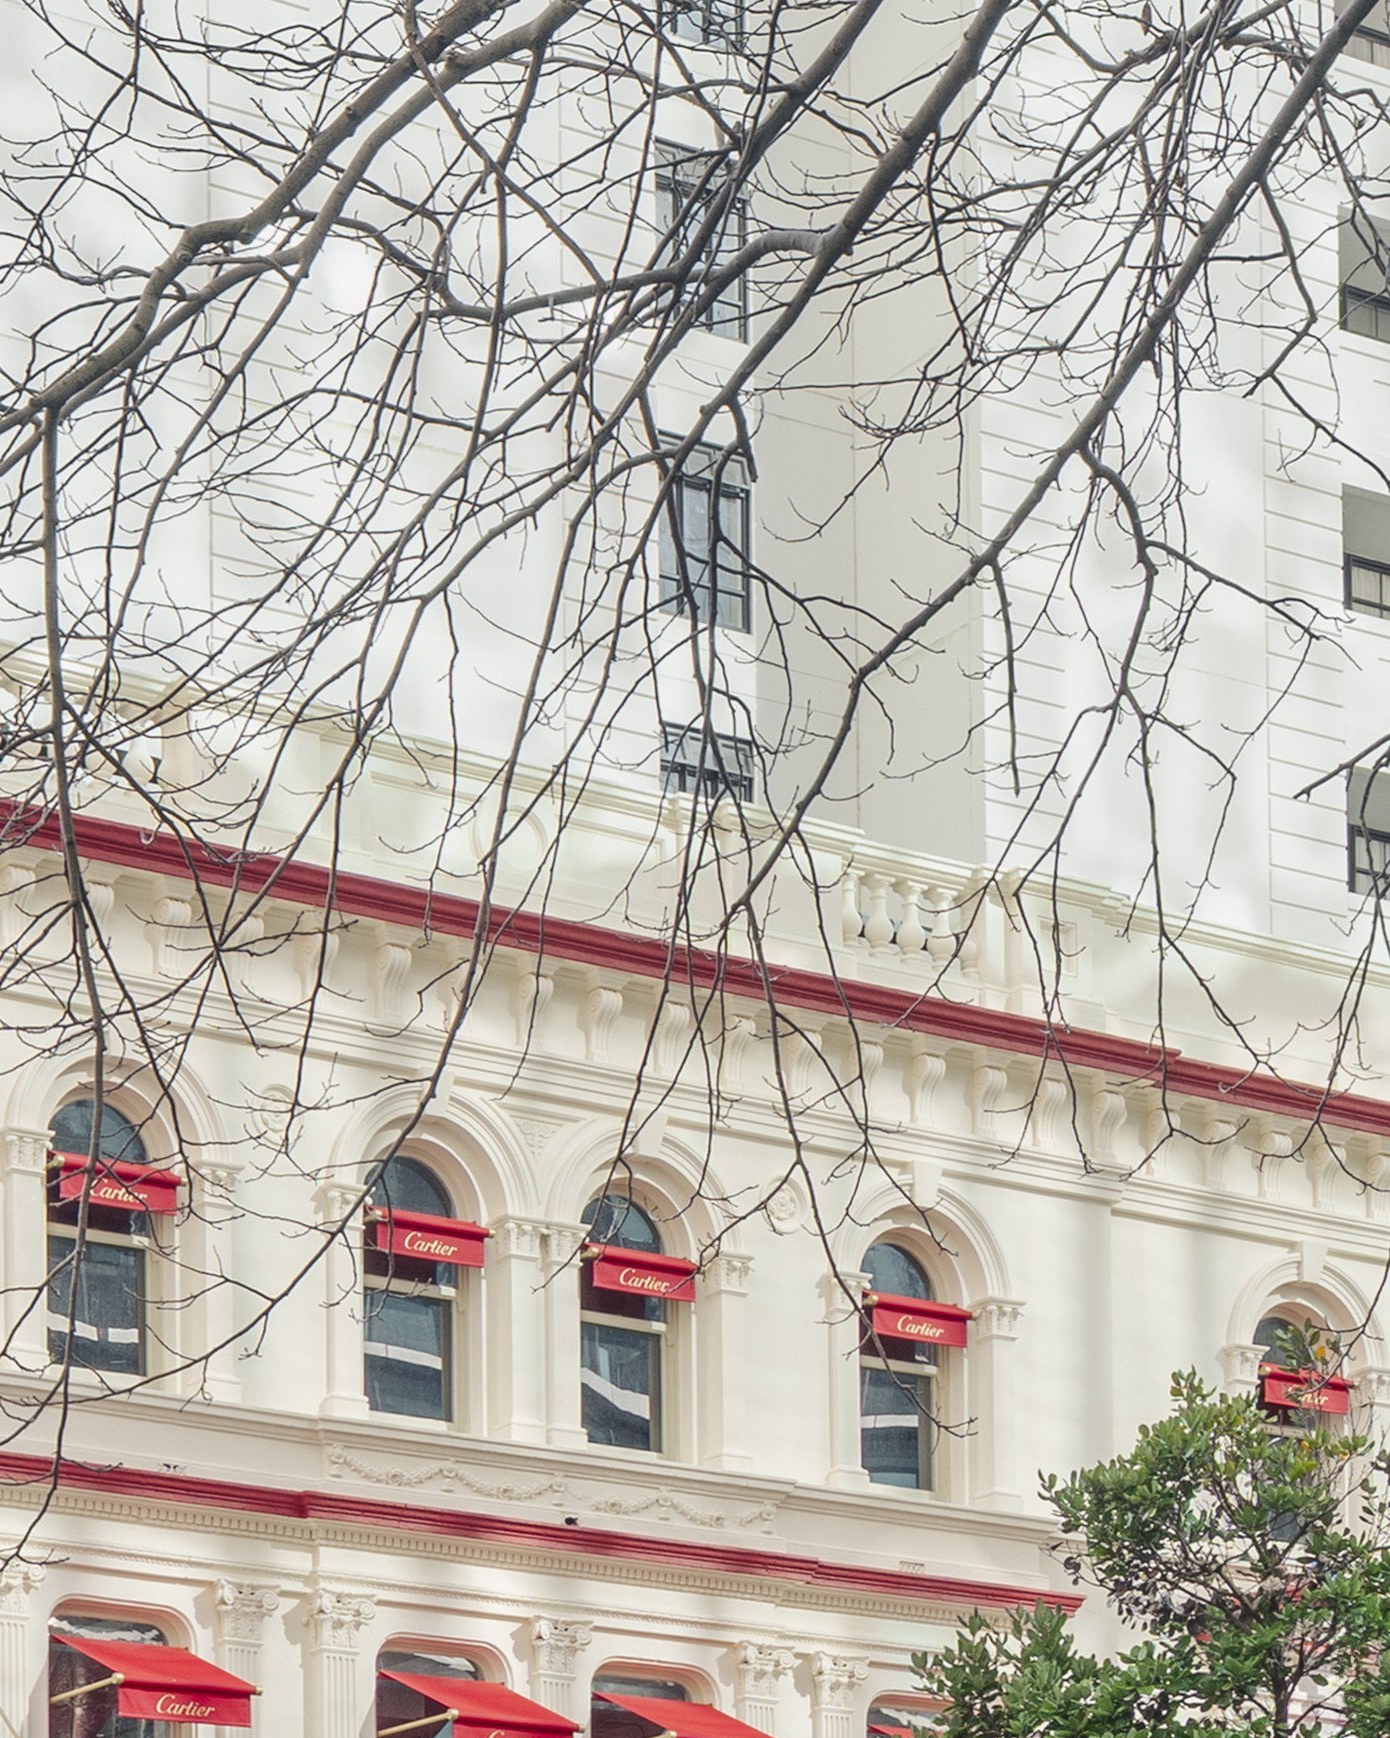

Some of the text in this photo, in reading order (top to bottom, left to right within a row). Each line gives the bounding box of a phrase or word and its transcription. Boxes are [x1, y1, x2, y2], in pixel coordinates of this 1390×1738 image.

[89, 1177, 148, 1203] Cartier
[404, 1231, 458, 1257] Cartier
[619, 1267, 671, 1293] Cartier
[897, 1314, 945, 1338] Cartier
[155, 1693, 216, 1717] Cartier
